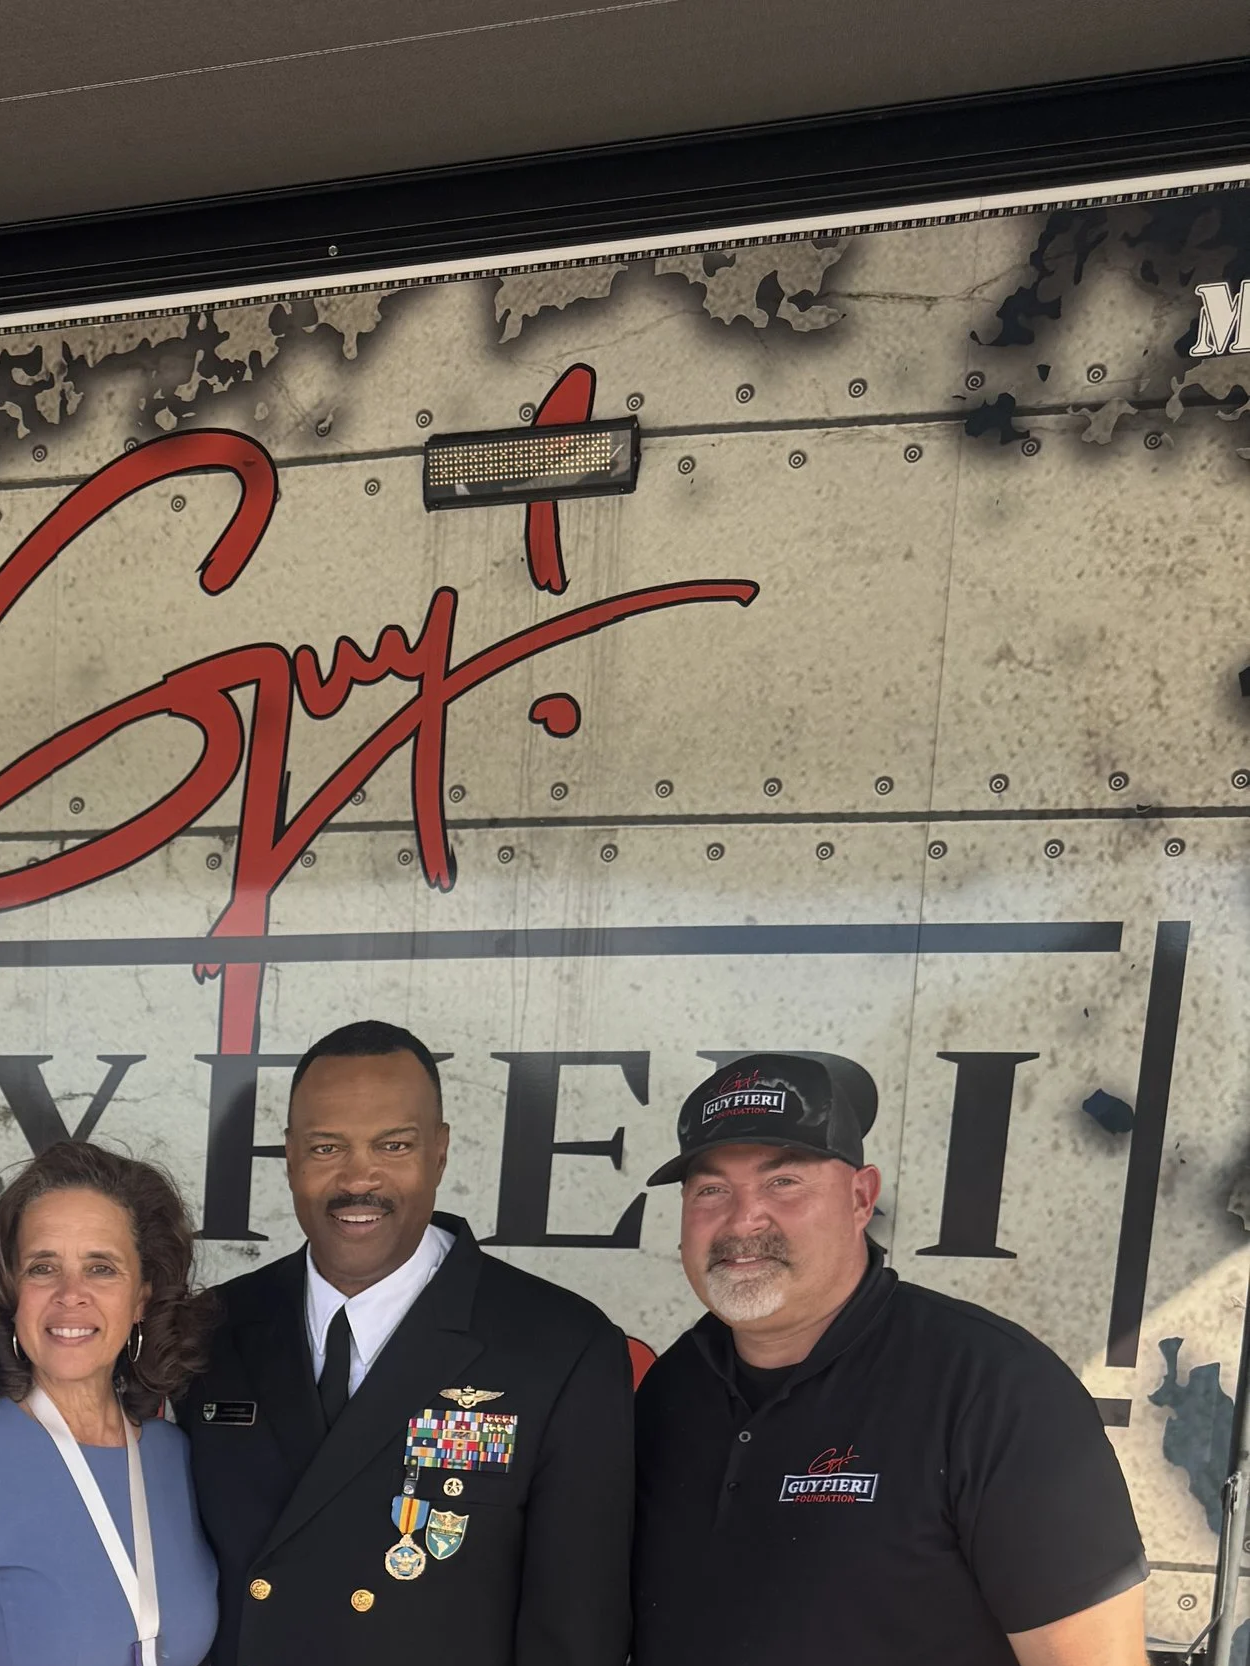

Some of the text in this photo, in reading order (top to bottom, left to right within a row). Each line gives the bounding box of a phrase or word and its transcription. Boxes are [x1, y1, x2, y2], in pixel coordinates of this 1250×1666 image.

[706, 1094, 780, 1115] GUY FIERI
[194, 1050, 1041, 1259] FEI
[787, 1479, 871, 1494] GUY FIERI
[794, 1494, 856, 1503] FOUNDATION
